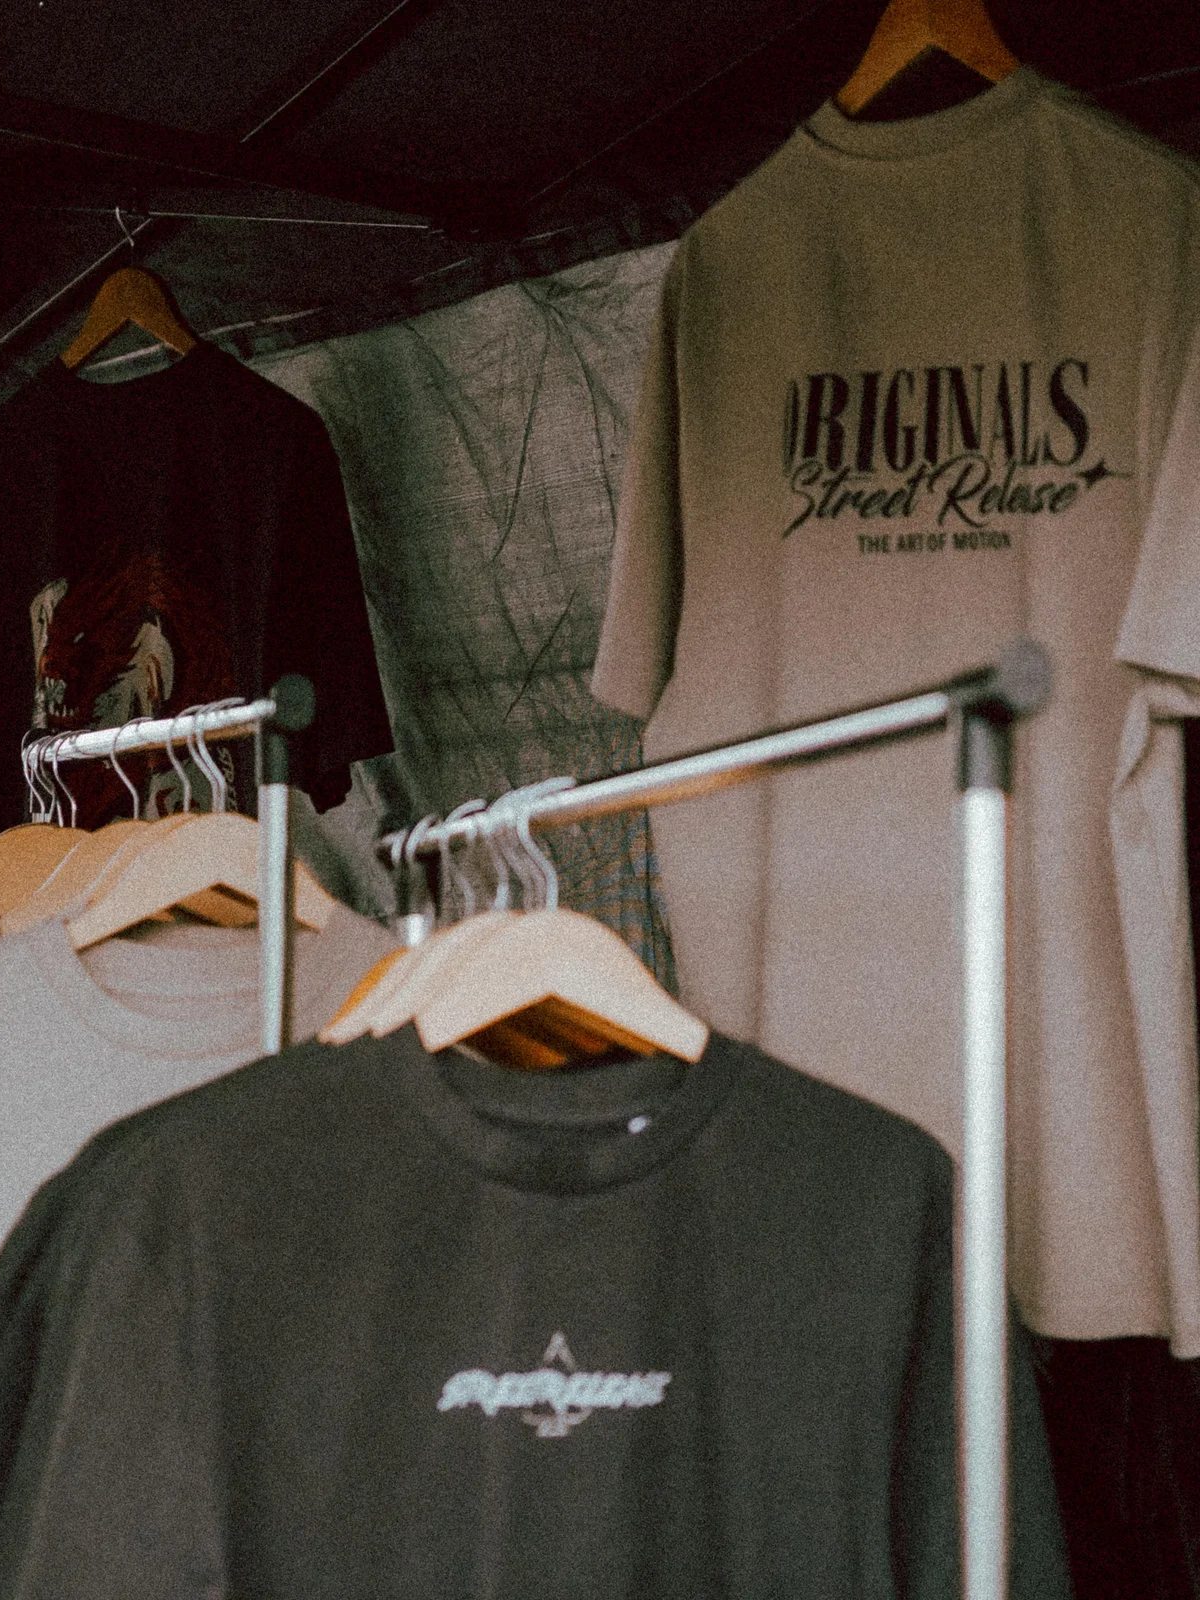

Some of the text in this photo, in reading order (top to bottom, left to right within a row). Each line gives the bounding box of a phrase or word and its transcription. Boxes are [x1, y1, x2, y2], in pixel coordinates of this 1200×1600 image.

[782, 447, 929, 540] Street
[857, 531, 1012, 554] THE ART OF MOTION
